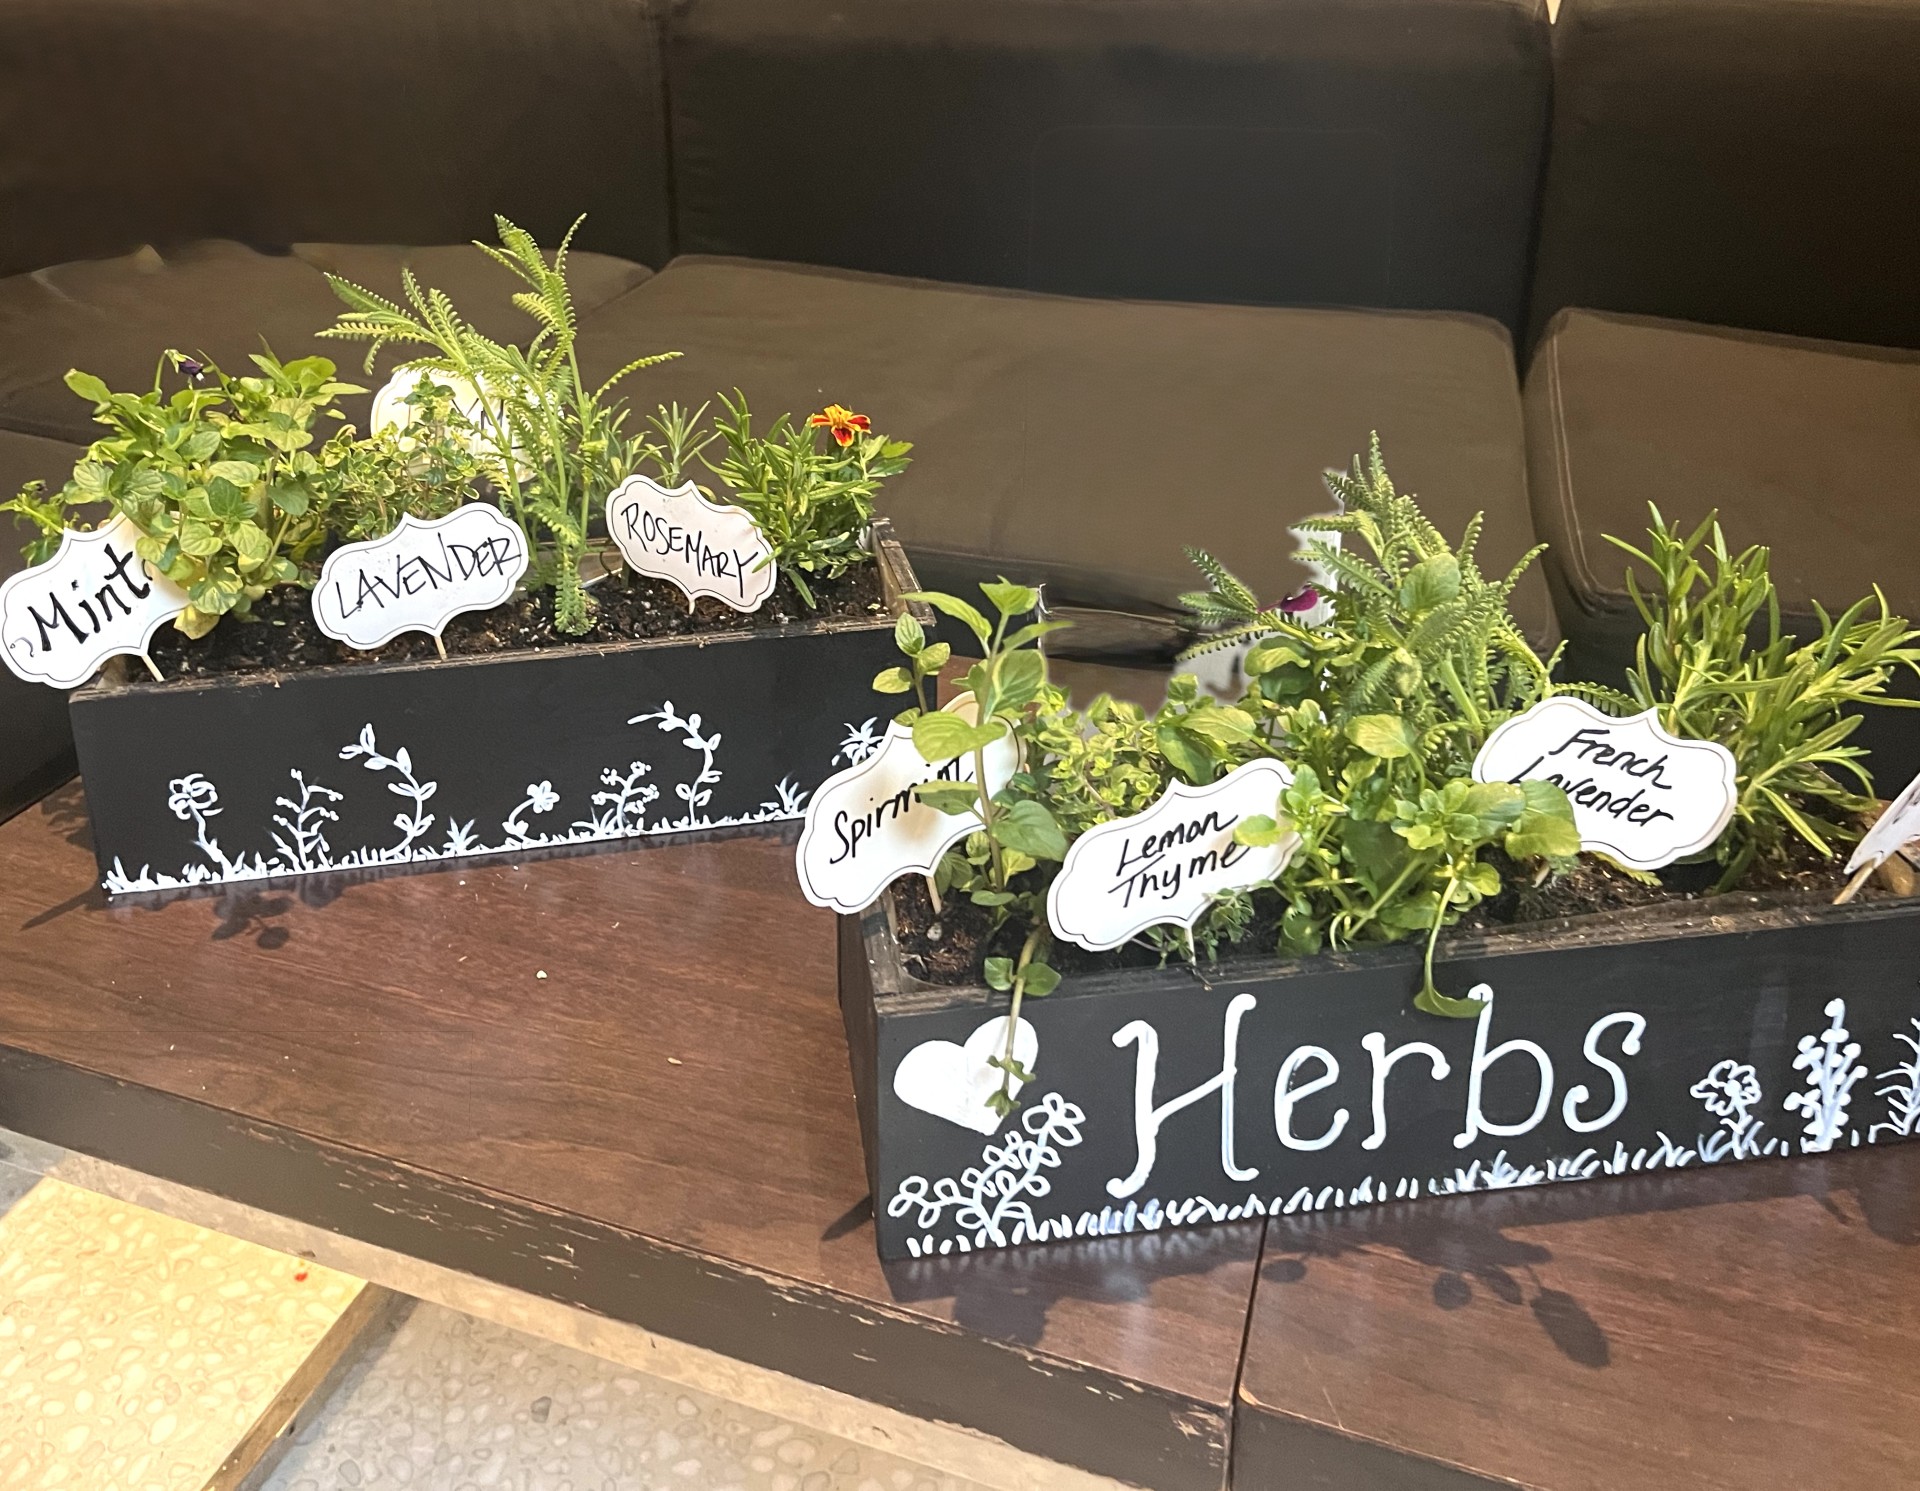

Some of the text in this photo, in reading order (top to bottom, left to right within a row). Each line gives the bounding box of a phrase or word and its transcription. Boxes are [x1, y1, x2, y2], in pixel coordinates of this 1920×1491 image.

[335, 531, 522, 620] LAVENDER
[620, 502, 759, 599] ROSEMARY
[27, 543, 151, 652] Mint
[1548, 728, 1672, 790] French
[1116, 811, 1239, 877] Lemon
[1107, 984, 1647, 1200] Herbs
